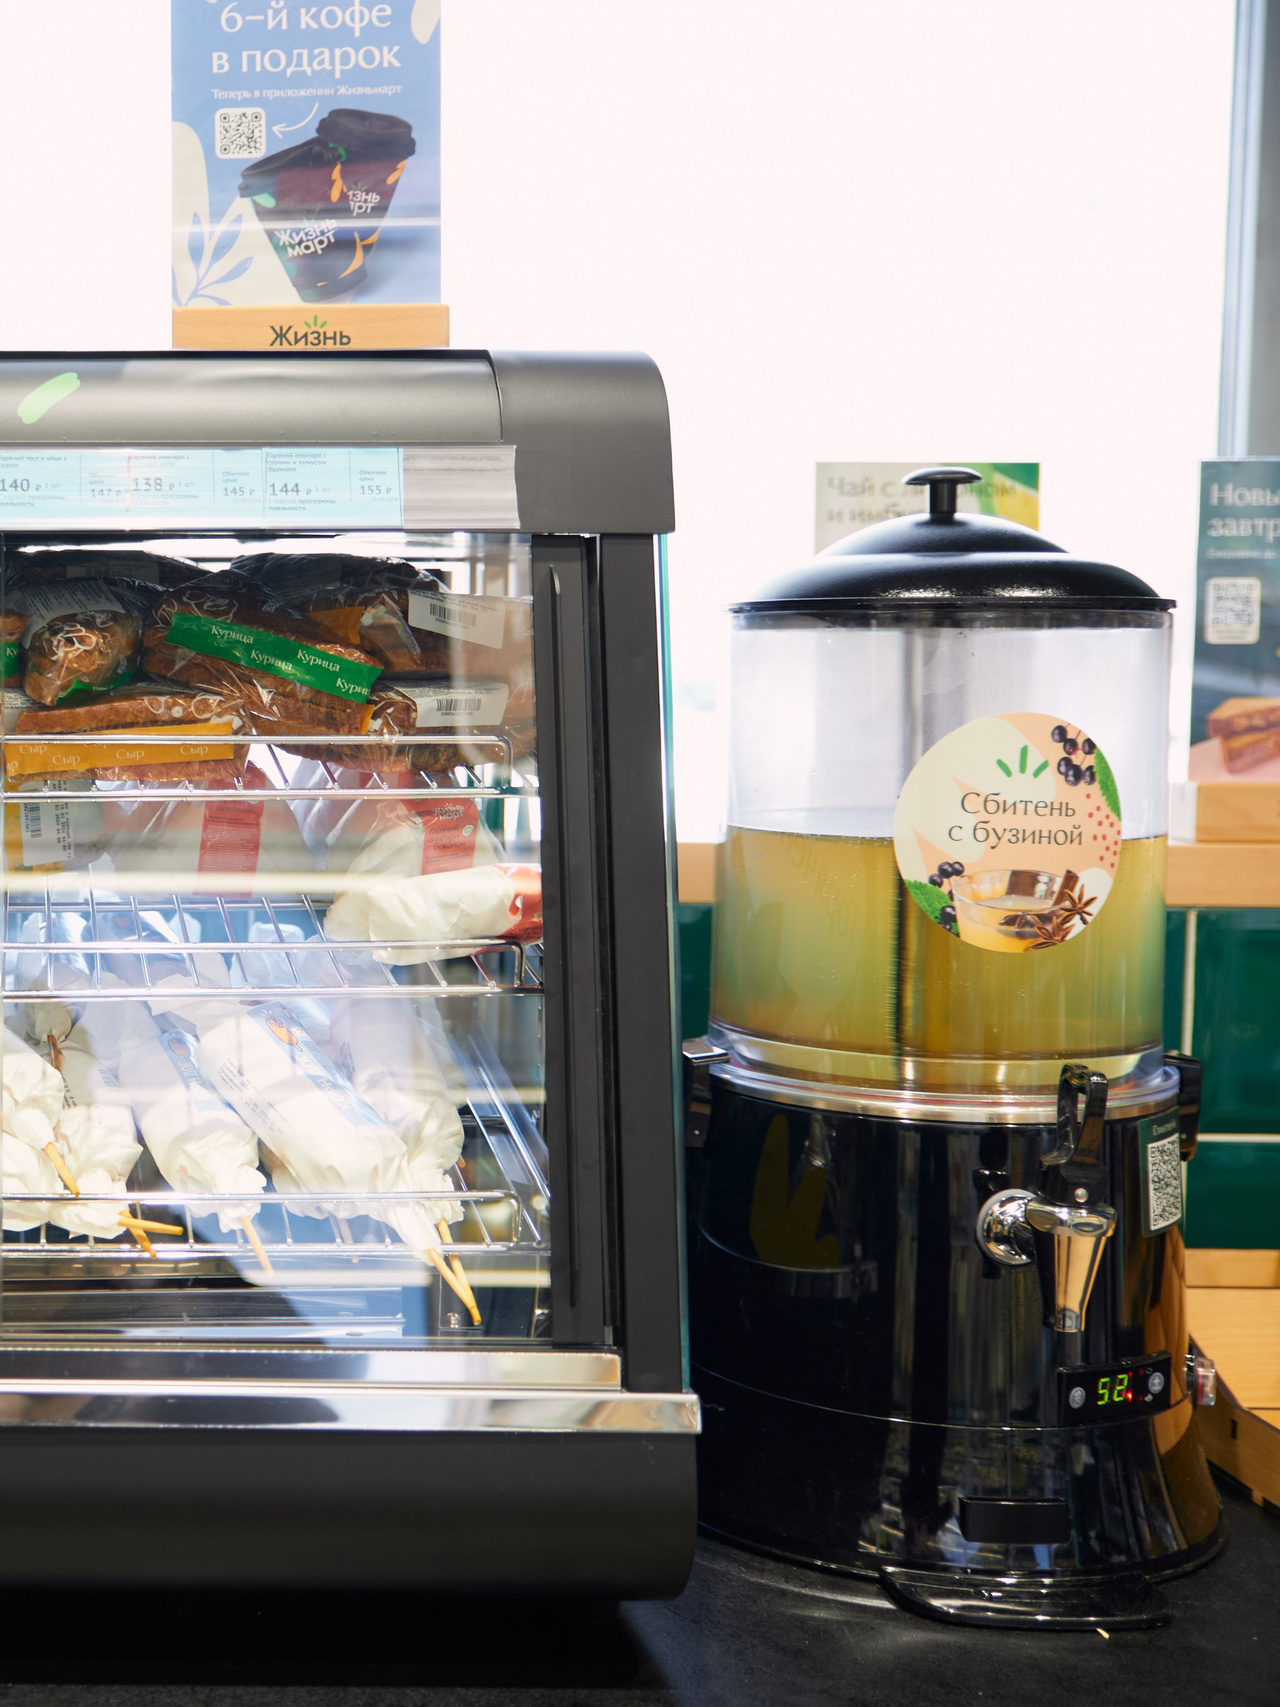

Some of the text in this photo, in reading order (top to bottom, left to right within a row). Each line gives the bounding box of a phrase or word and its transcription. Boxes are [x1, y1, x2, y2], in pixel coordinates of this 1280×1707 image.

[301, 0, 392, 37] кофе
[212, 45, 401, 79] в подарок
[211, 88, 252, 100] Теперь
[263, 88, 334, 99] приложении
[337, 84, 403, 97] Жизньмарт
[274, 218, 337, 247] Жизнь
[287, 231, 337, 258] март
[269, 325, 351, 346] Жизнь
[0, 479, 30, 492] 140
[132, 478, 163, 491] 138
[223, 487, 245, 496] 145
[269, 483, 301, 496] 144
[360, 485, 382, 495] 155
[827, 477, 875, 497] Чай
[880, 482, 891, 497] с
[211, 625, 255, 644] Курица
[251, 649, 293, 671] Курица
[297, 649, 340, 672] Курица
[20, 744, 47, 755] Сыр
[116, 749, 144, 760] Сыр
[180, 744, 209, 756] Сыр
[52, 755, 81, 766] Сыр
[960, 791, 1076, 818] Сбитень
[948, 820, 1083, 850] с бузиной
[1097, 1373, 1129, 1406] 52
